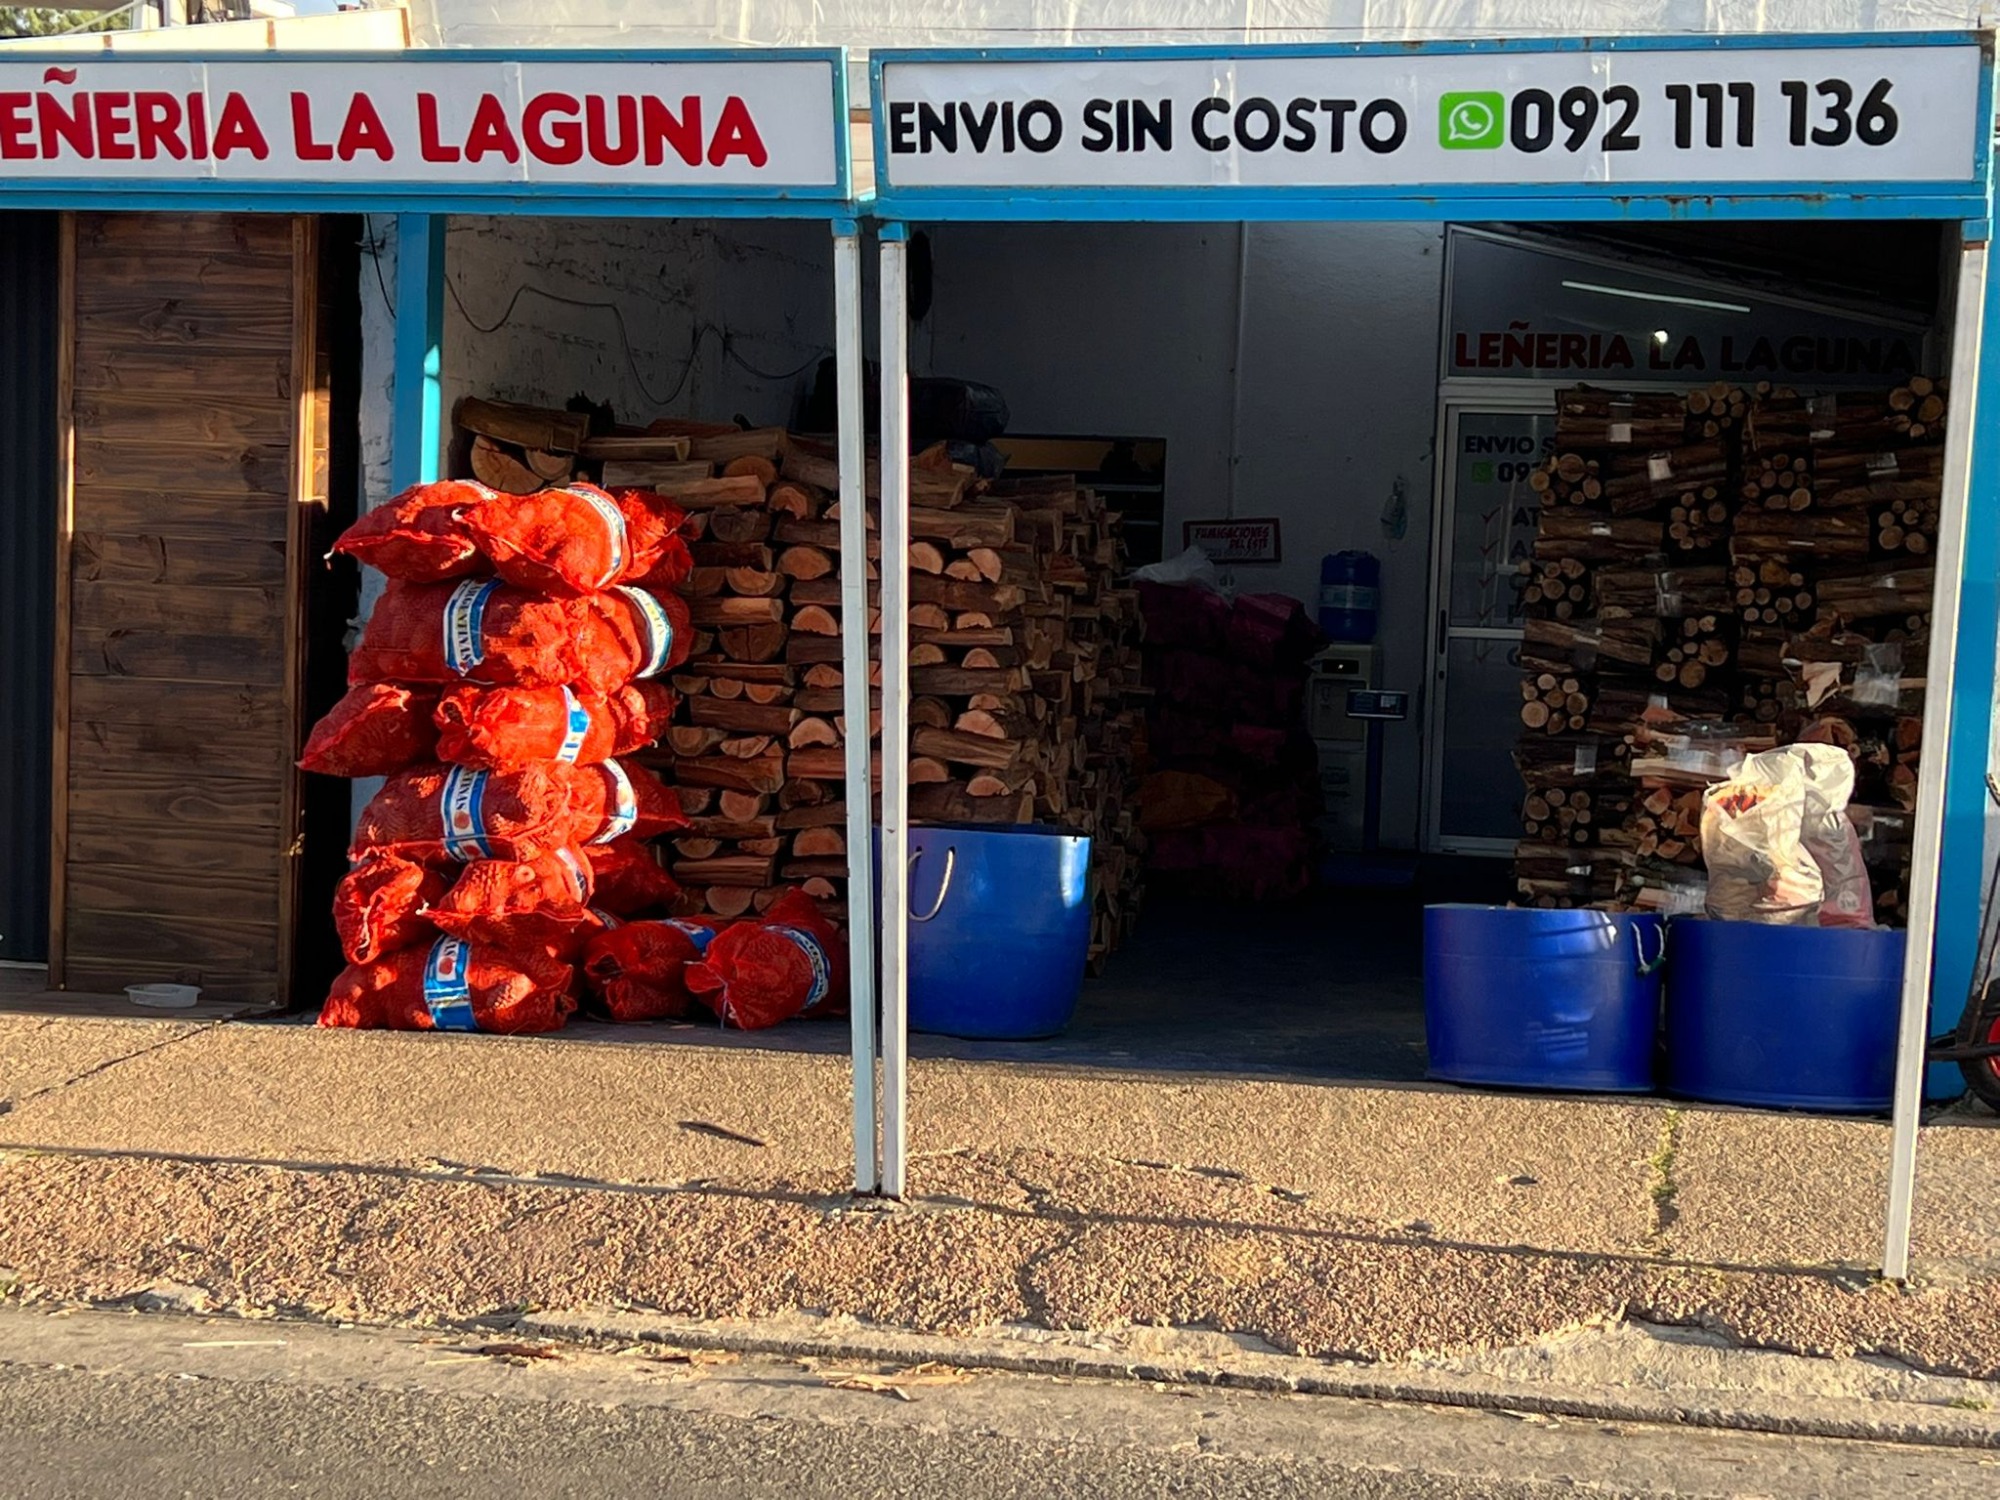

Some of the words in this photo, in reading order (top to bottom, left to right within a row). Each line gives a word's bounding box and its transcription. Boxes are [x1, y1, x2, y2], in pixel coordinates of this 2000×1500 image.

[0, 68, 269, 160] EÑERIA
[292, 92, 394, 160] LA
[418, 92, 767, 167] LAGUNA
[890, 100, 1062, 153] ENVIO
[1082, 99, 1171, 152] SIN
[1192, 98, 1406, 153] COSTO
[1511, 86, 1639, 152] 092
[1666, 83, 1754, 148] 111
[1782, 79, 1897, 146] 136
[1454, 321, 1634, 369] LEÑERIA
[1649, 333, 1705, 371] LA
[1720, 335, 1916, 374] LAGUNA
[1465, 435, 1534, 454] ENVIO
[1195, 526, 1269, 539] FUMIGACIONES
[457, 583, 482, 661] ARGENTINAS
